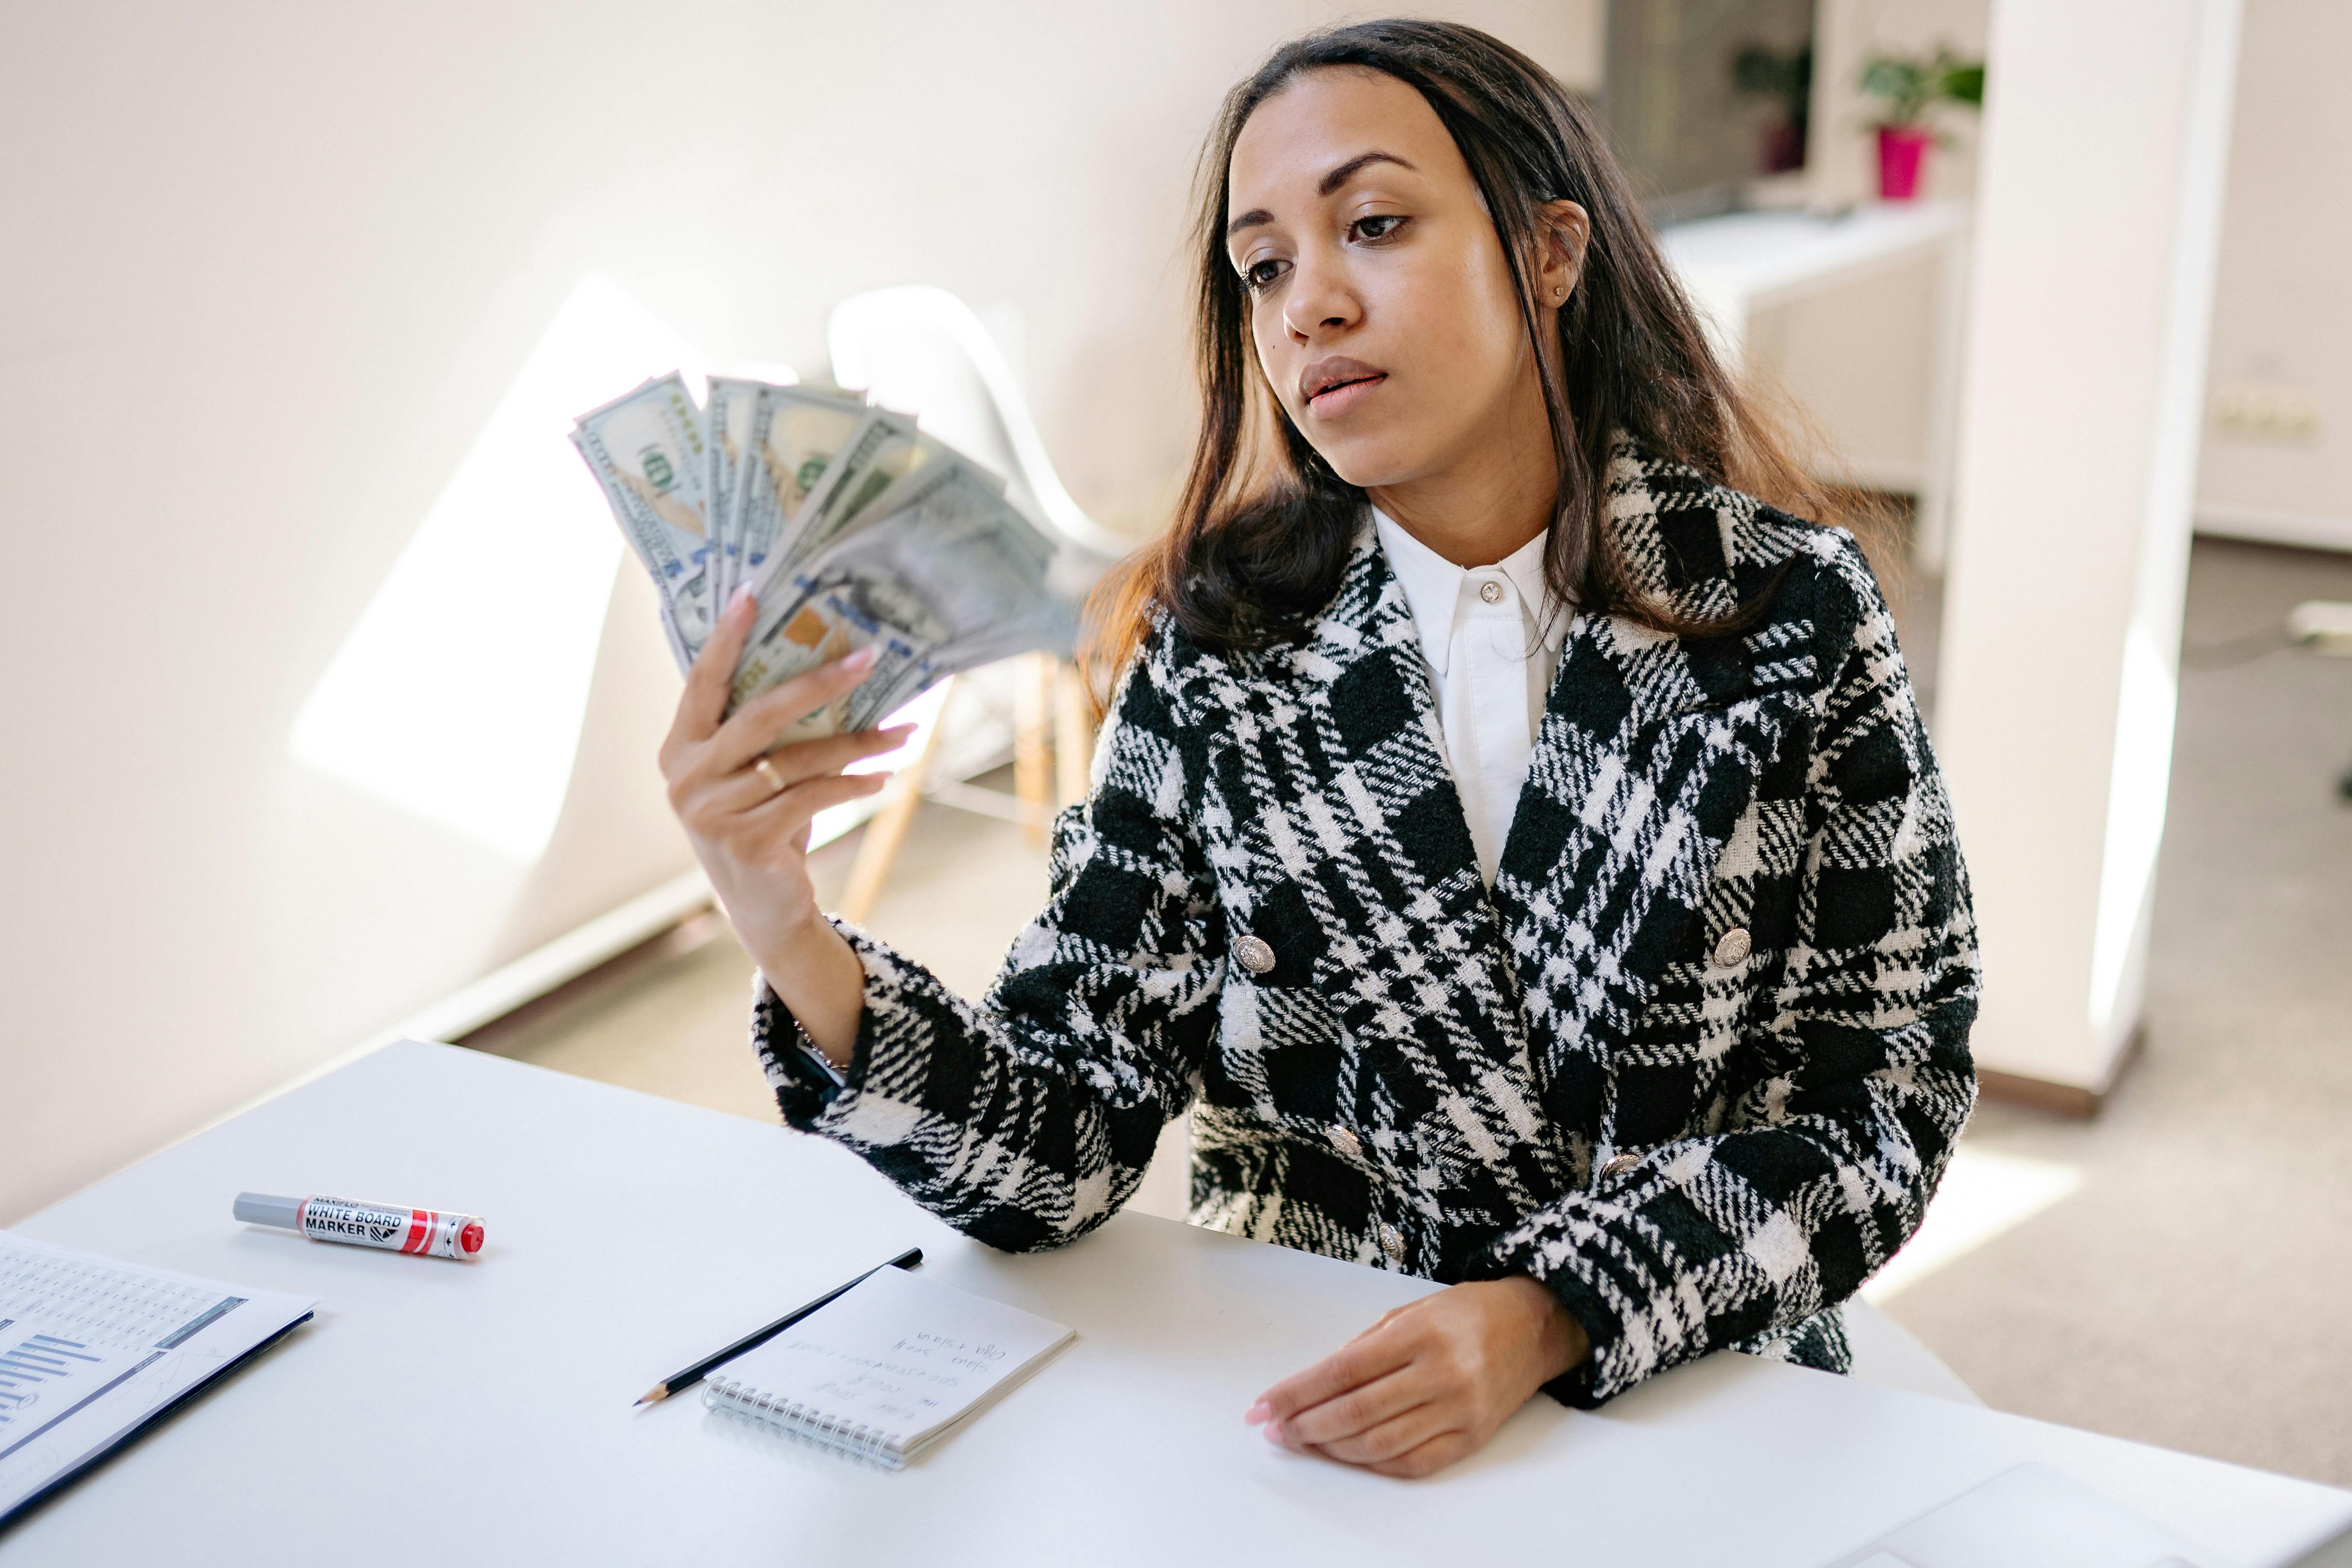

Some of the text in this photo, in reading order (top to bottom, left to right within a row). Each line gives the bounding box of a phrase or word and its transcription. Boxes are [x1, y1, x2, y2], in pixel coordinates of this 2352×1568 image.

[309, 1204, 352, 1221] WHITE
[356, 1211, 402, 1228] BOARD
[306, 1217, 365, 1236] MARKER
[975, 1344, 1006, 1361] Olga
